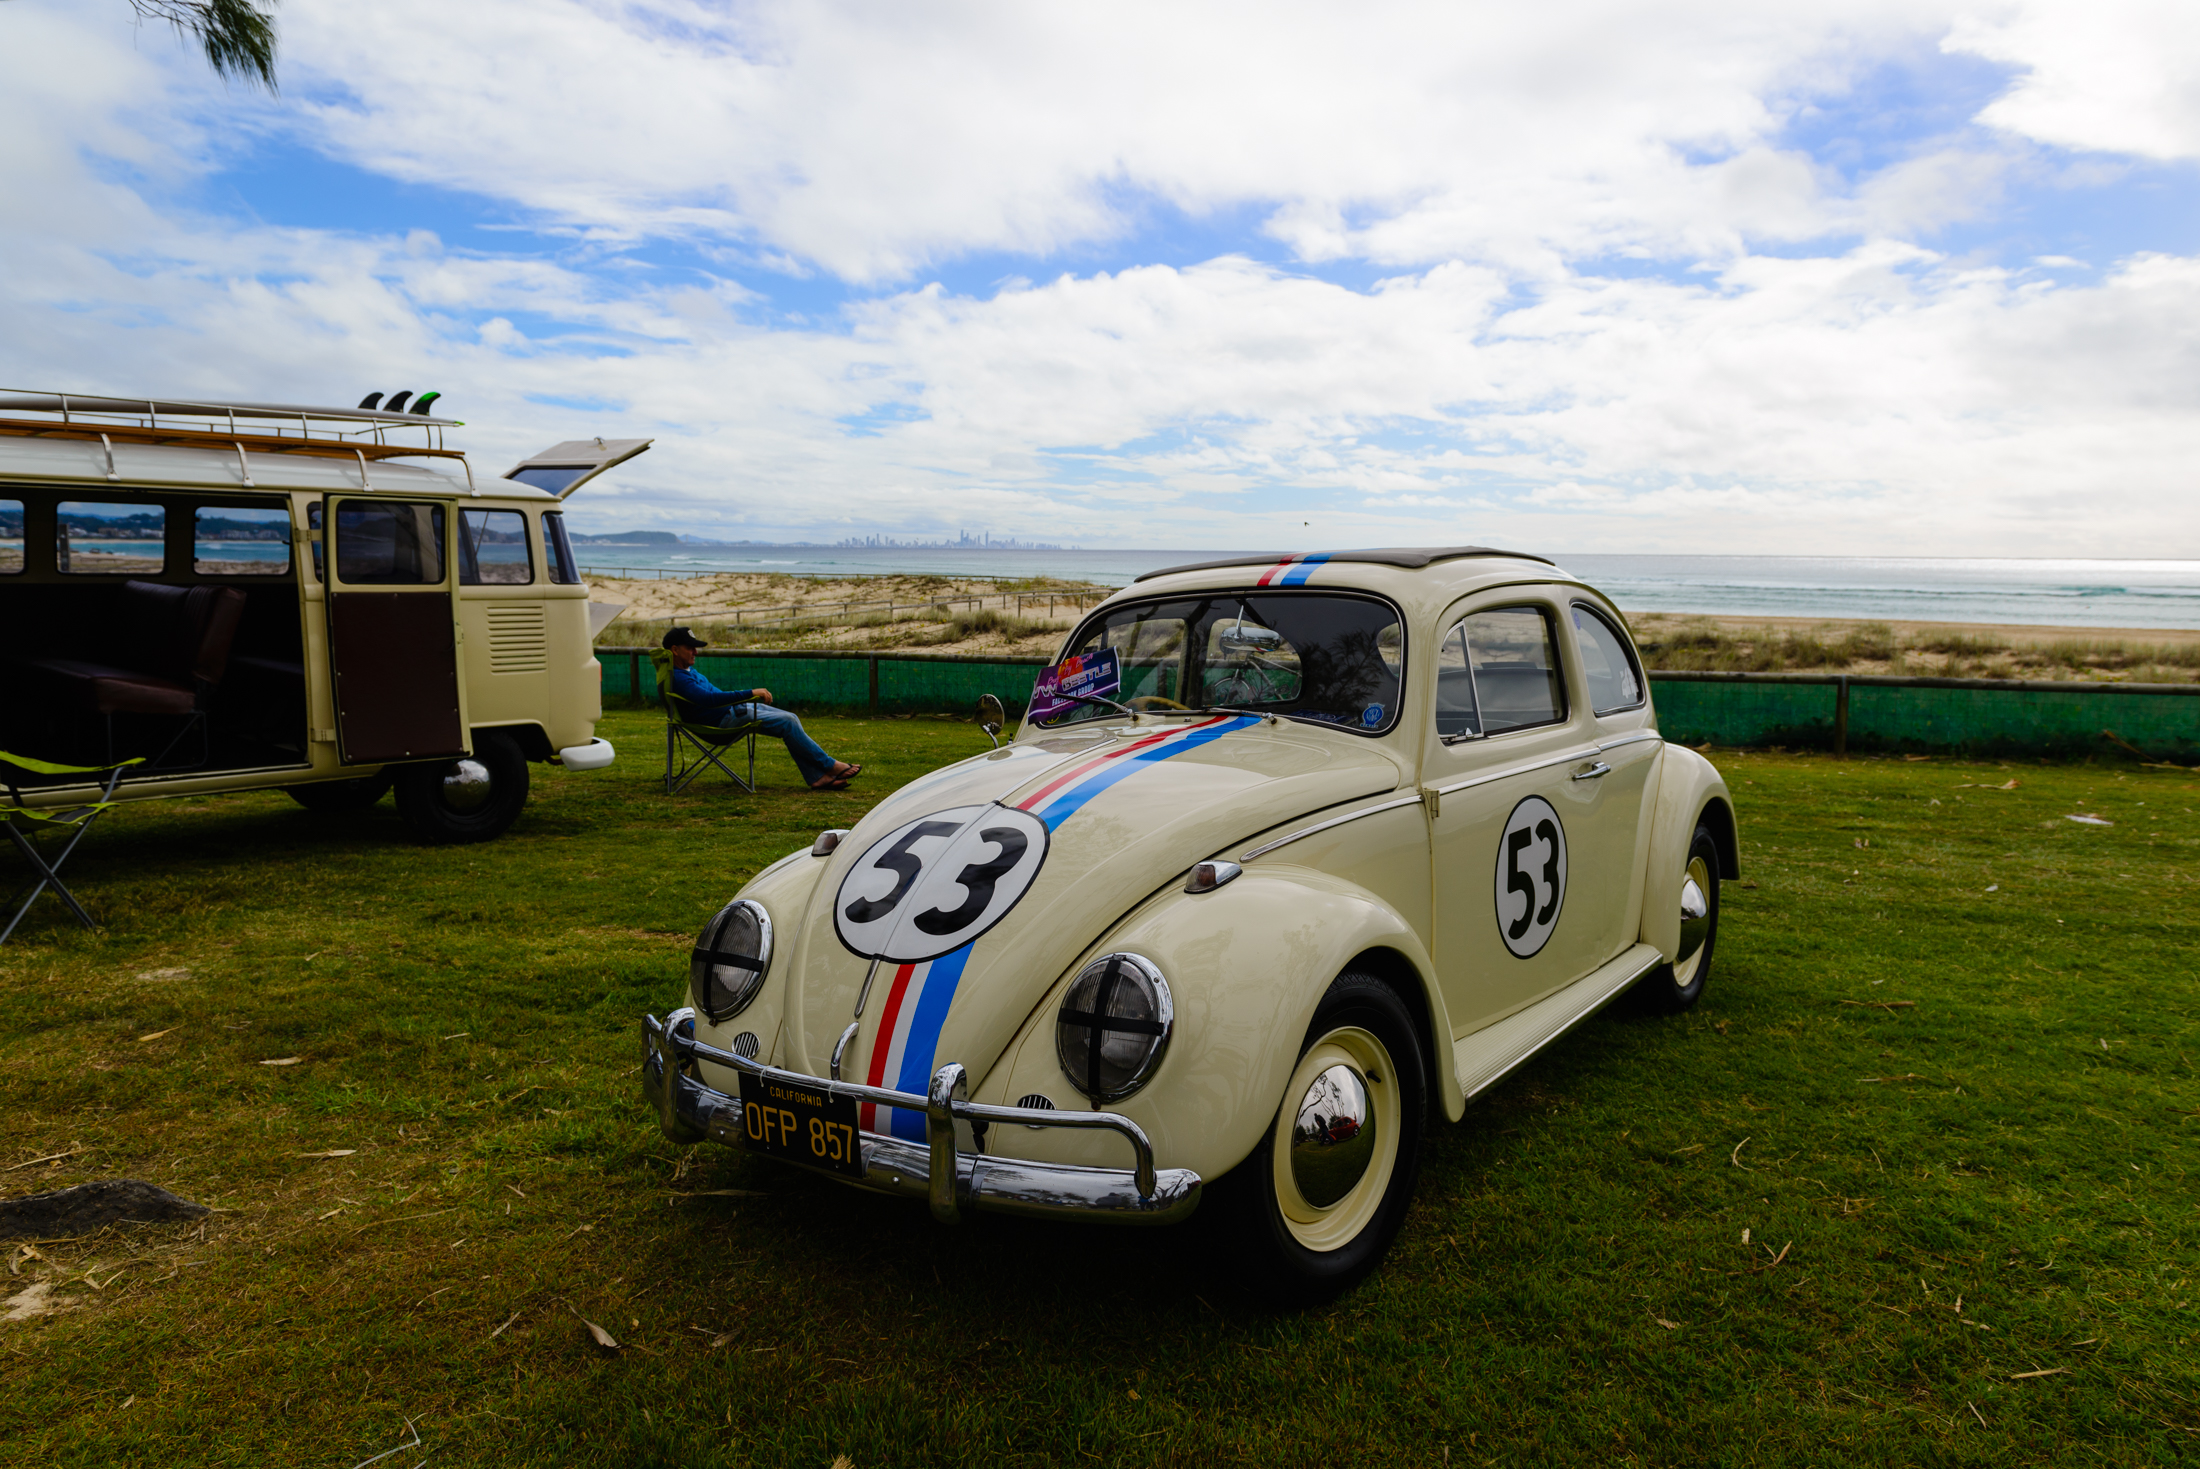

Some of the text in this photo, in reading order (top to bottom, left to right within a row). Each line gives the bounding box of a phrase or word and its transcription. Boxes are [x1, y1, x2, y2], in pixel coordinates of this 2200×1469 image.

[1061, 662, 1112, 692] BEETLE
[1078, 683, 1095, 697] GROUP
[845, 821, 1029, 936] 53
[1507, 818, 1560, 941] 53
[769, 1086, 823, 1108] CALIFORNIA
[745, 1101, 854, 1165] OFP 857
